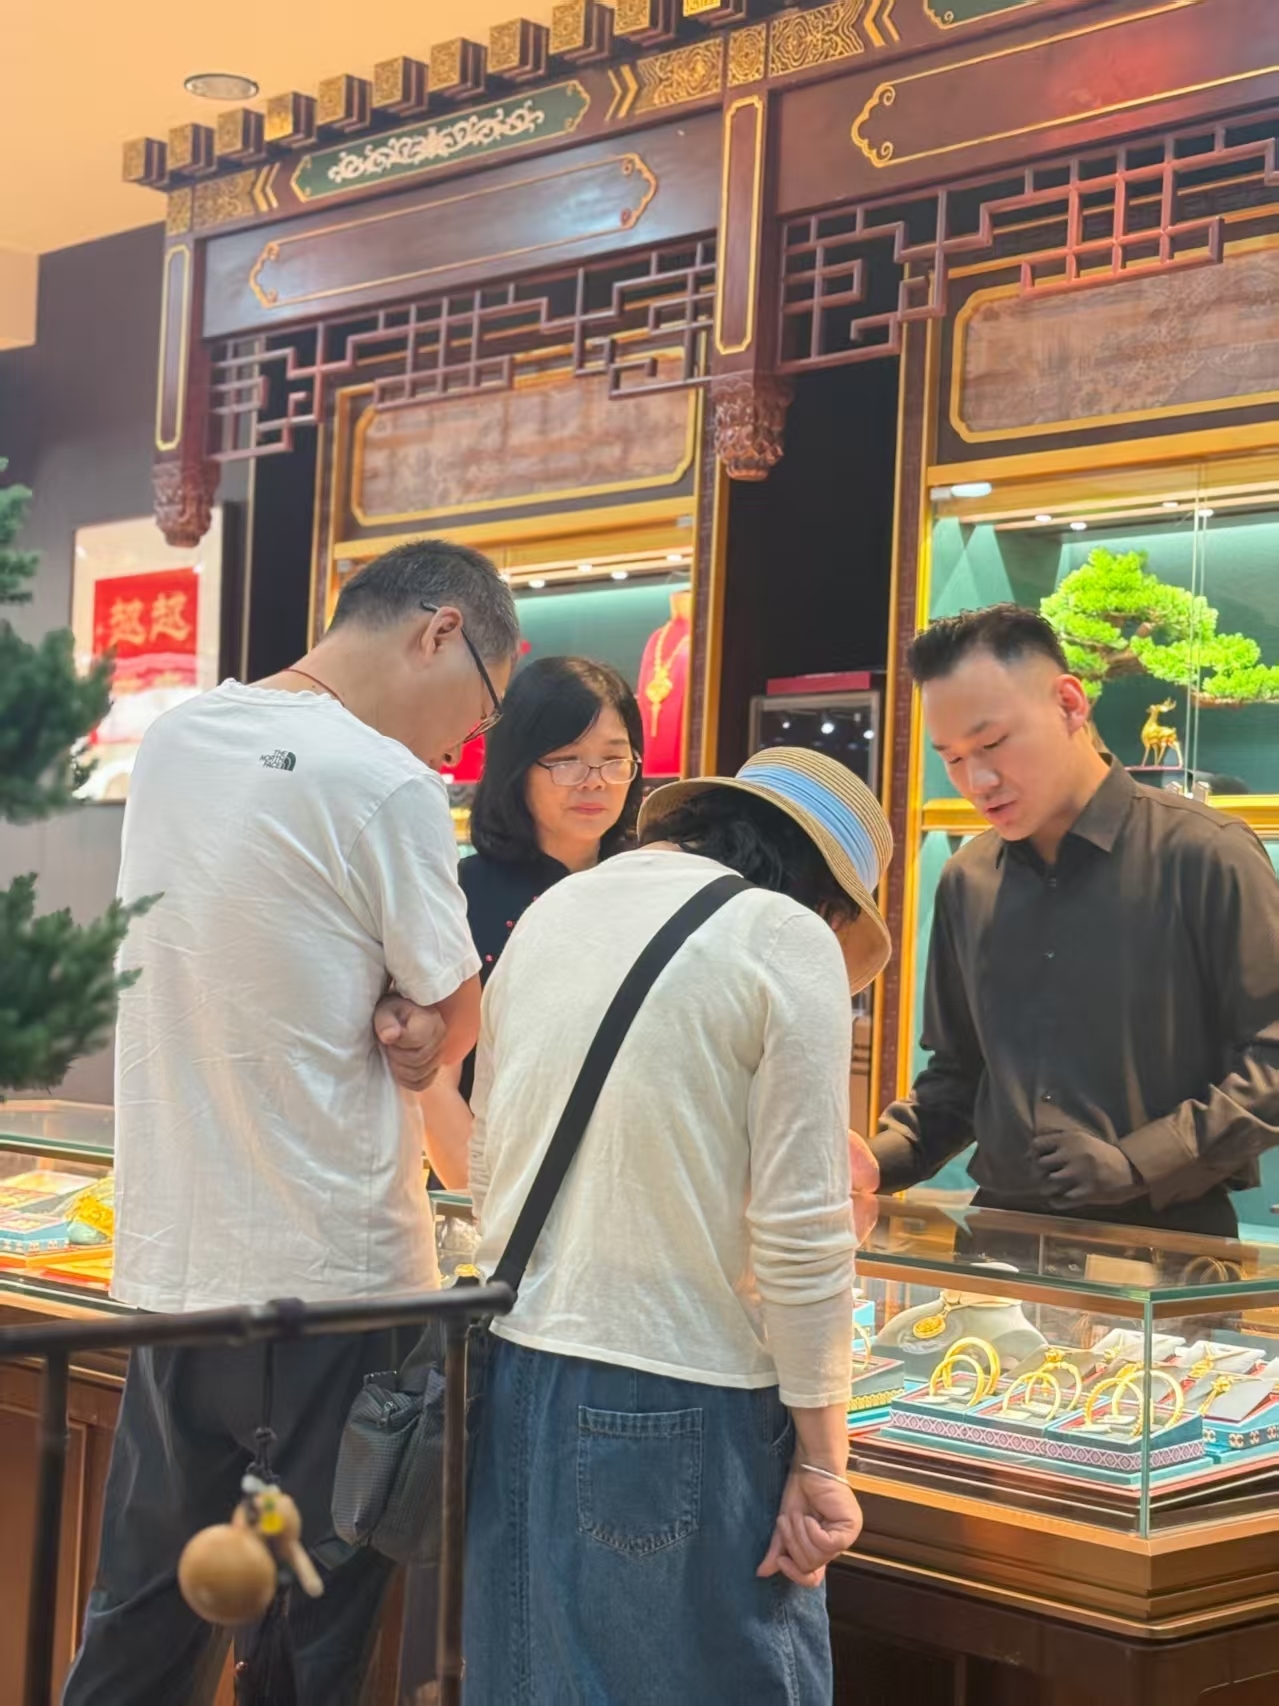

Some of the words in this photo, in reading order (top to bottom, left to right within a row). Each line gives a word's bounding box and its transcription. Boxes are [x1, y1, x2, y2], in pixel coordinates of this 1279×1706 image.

[274, 749, 287, 757] THE
[259, 754, 284, 765] NORTH
[263, 761, 282, 770] FACE
